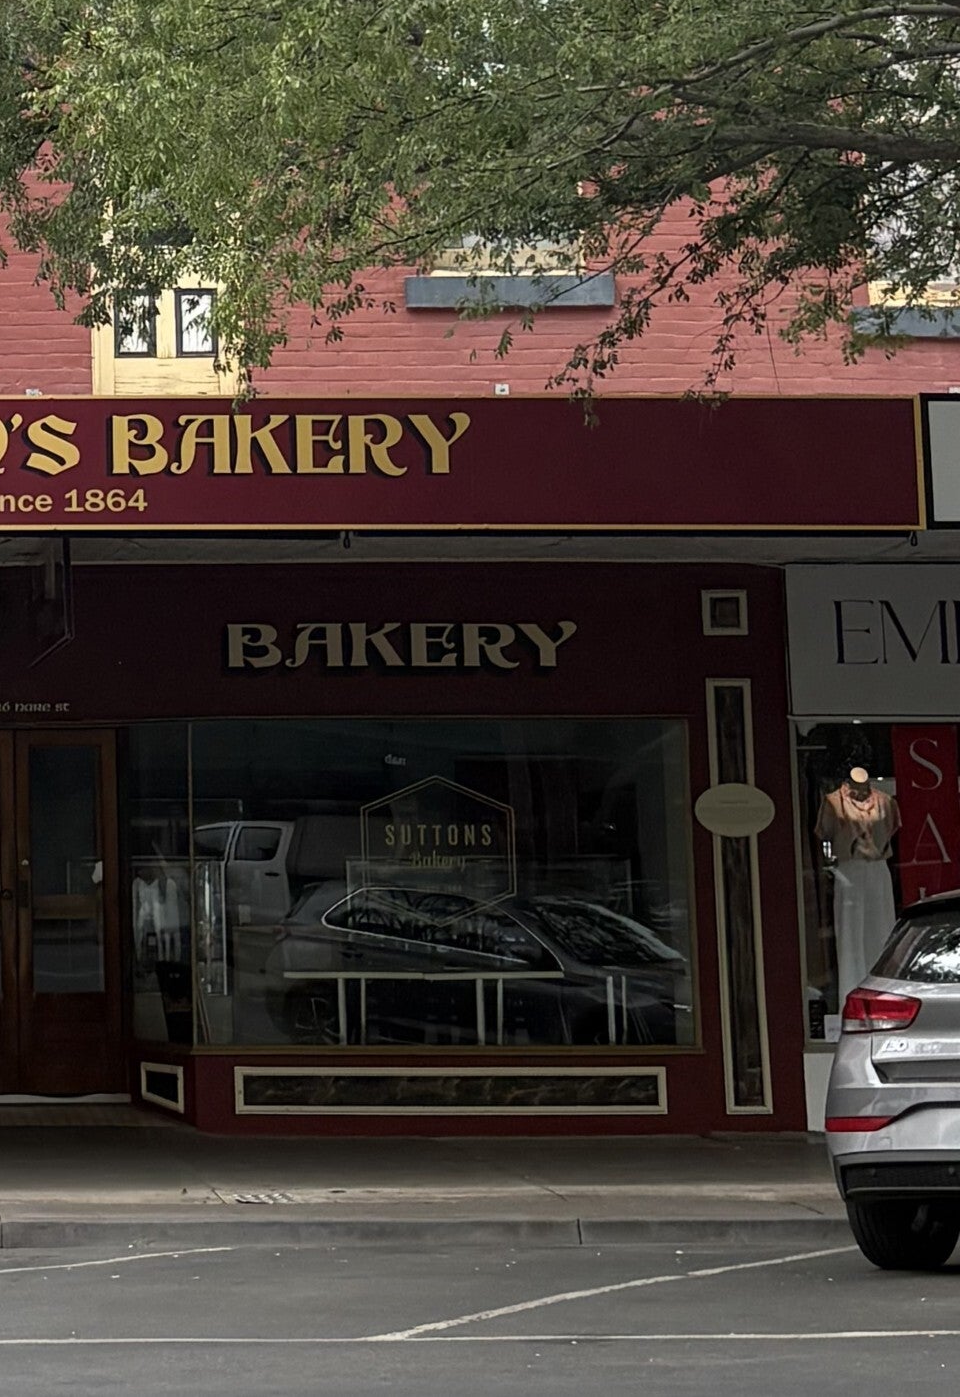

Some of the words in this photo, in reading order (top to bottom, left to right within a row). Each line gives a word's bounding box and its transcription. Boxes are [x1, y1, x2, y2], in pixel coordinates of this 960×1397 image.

[112, 411, 471, 477] BAKERY
[63, 488, 148, 513] 1864
[226, 619, 577, 670] BAKERY
[384, 823, 493, 847] SUTTONS
[908, 737, 952, 900] SA
